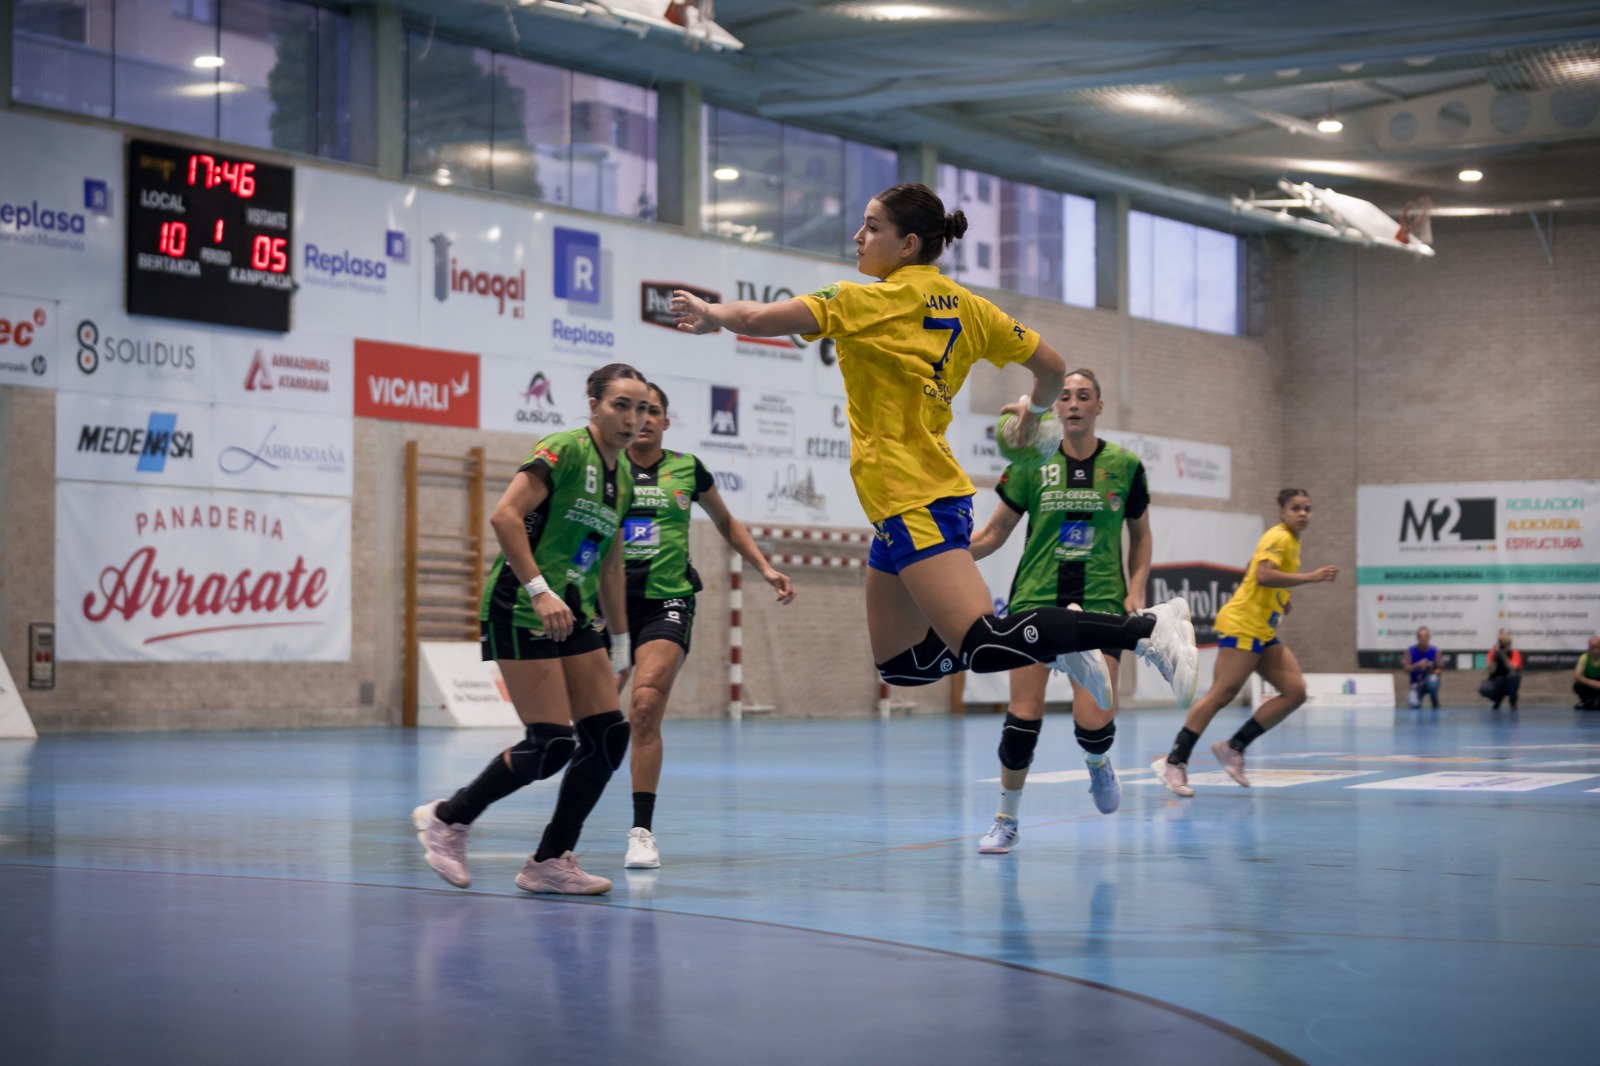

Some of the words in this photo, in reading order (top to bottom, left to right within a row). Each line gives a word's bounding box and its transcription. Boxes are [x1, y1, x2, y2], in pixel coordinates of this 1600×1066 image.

[188, 155, 256, 199] 17:46
[0, 200, 85, 234] eplasa
[140, 189, 186, 213] LOCAL
[214, 218, 224, 243] 1
[246, 207, 288, 230] VISITANTE
[159, 222, 187, 257] 10
[251, 235, 287, 272] 05
[304, 243, 387, 280] Replasa
[573, 255, 594, 292] R
[0, 317, 35, 348] ec
[552, 318, 615, 347] Replasa
[922, 316, 963, 372] 7
[104, 336, 196, 370] SOLIDUS
[369, 374, 449, 412] VICARLI
[78, 424, 194, 459] MEDENASA
[585, 465, 597, 494] 6
[1040, 463, 1061, 487] 19
[136, 505, 284, 541] PANADERIA
[635, 526, 647, 537] R
[1069, 529, 1082, 541] R
[1400, 497, 1462, 543] M2
[1505, 537, 1584, 551] ESTRUCTURA
[83, 546, 329, 622] Arrasate
[1152, 577, 1240, 619] PedroLui
